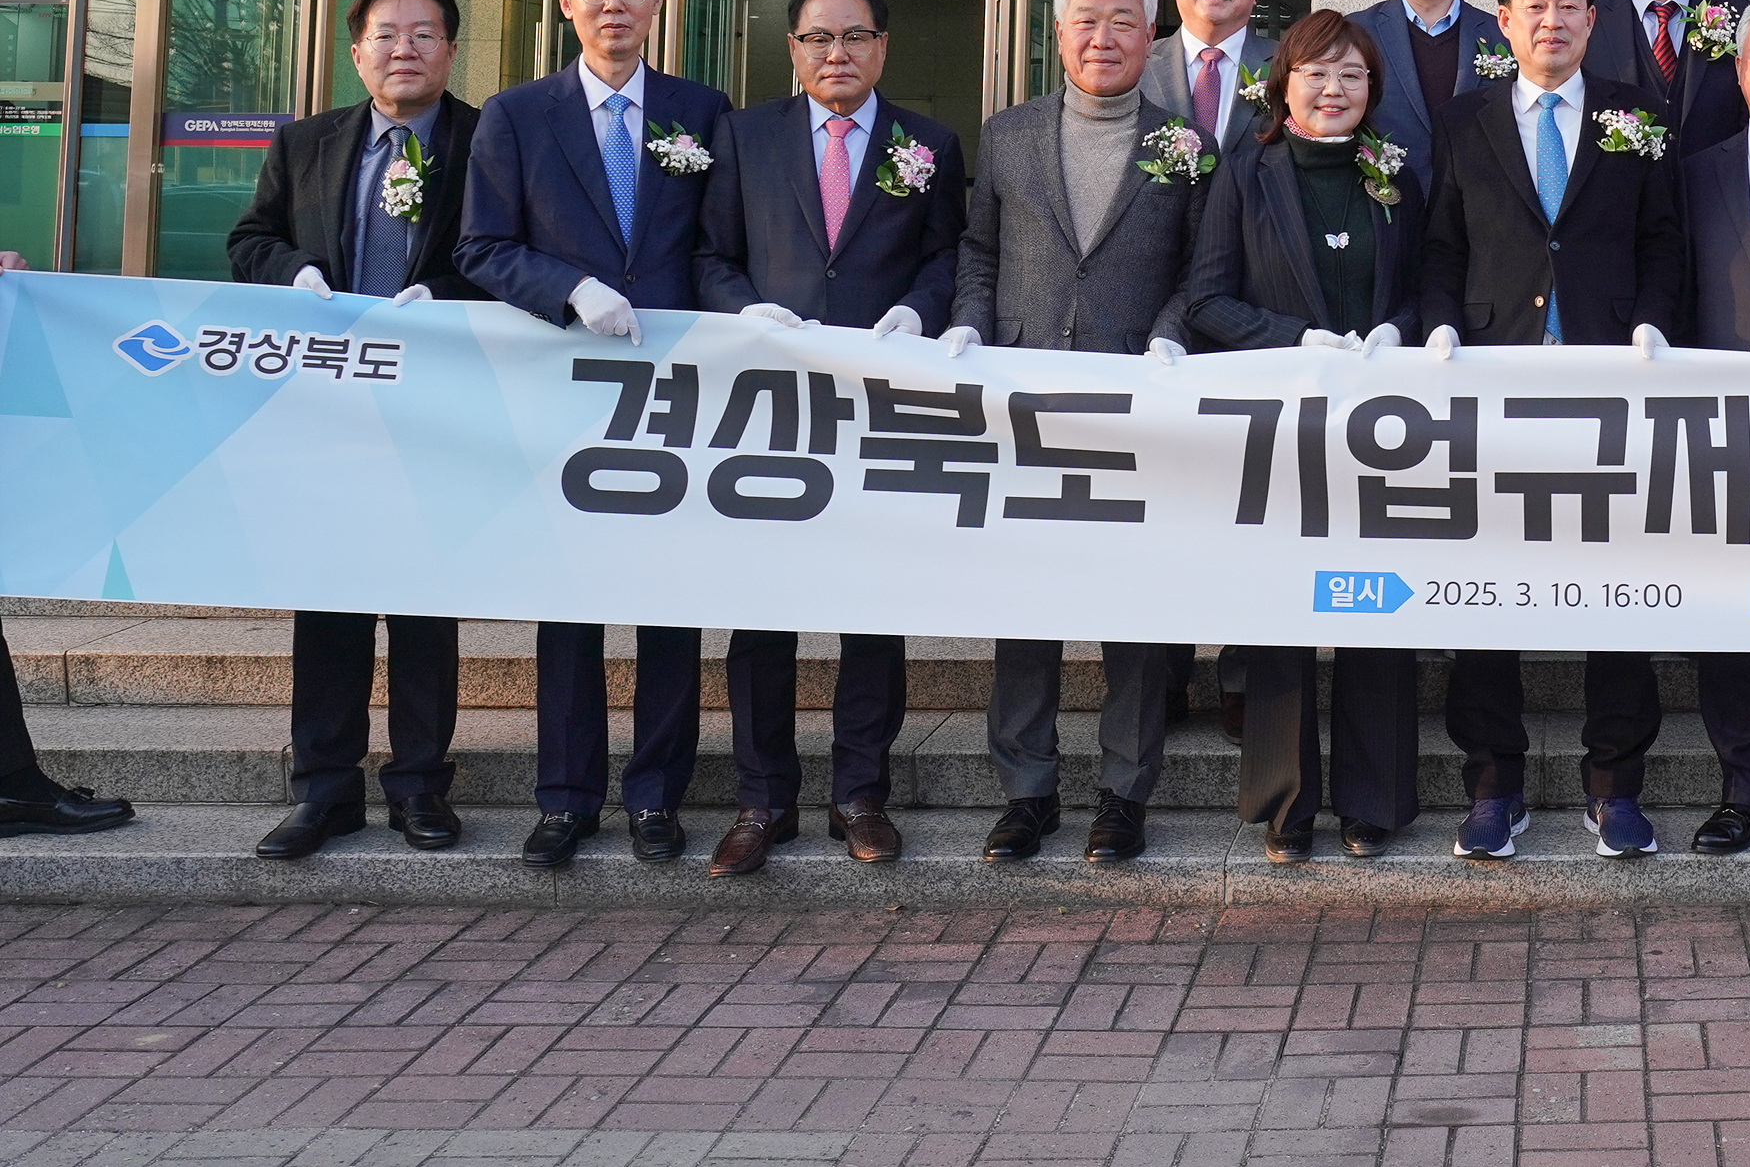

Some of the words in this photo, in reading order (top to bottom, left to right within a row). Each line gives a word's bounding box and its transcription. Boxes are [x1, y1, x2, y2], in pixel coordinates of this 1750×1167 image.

[184, 119, 219, 132] GEPA
[197, 328, 402, 380] 경상북도
[561, 357, 1146, 529] 경상북도
[1327, 576, 1385, 608] 일시
[1425, 580, 1503, 607] 2025.
[1515, 582, 1537, 607] 3.
[1551, 582, 1588, 608] 10.
[1602, 583, 1682, 608] 16:00
